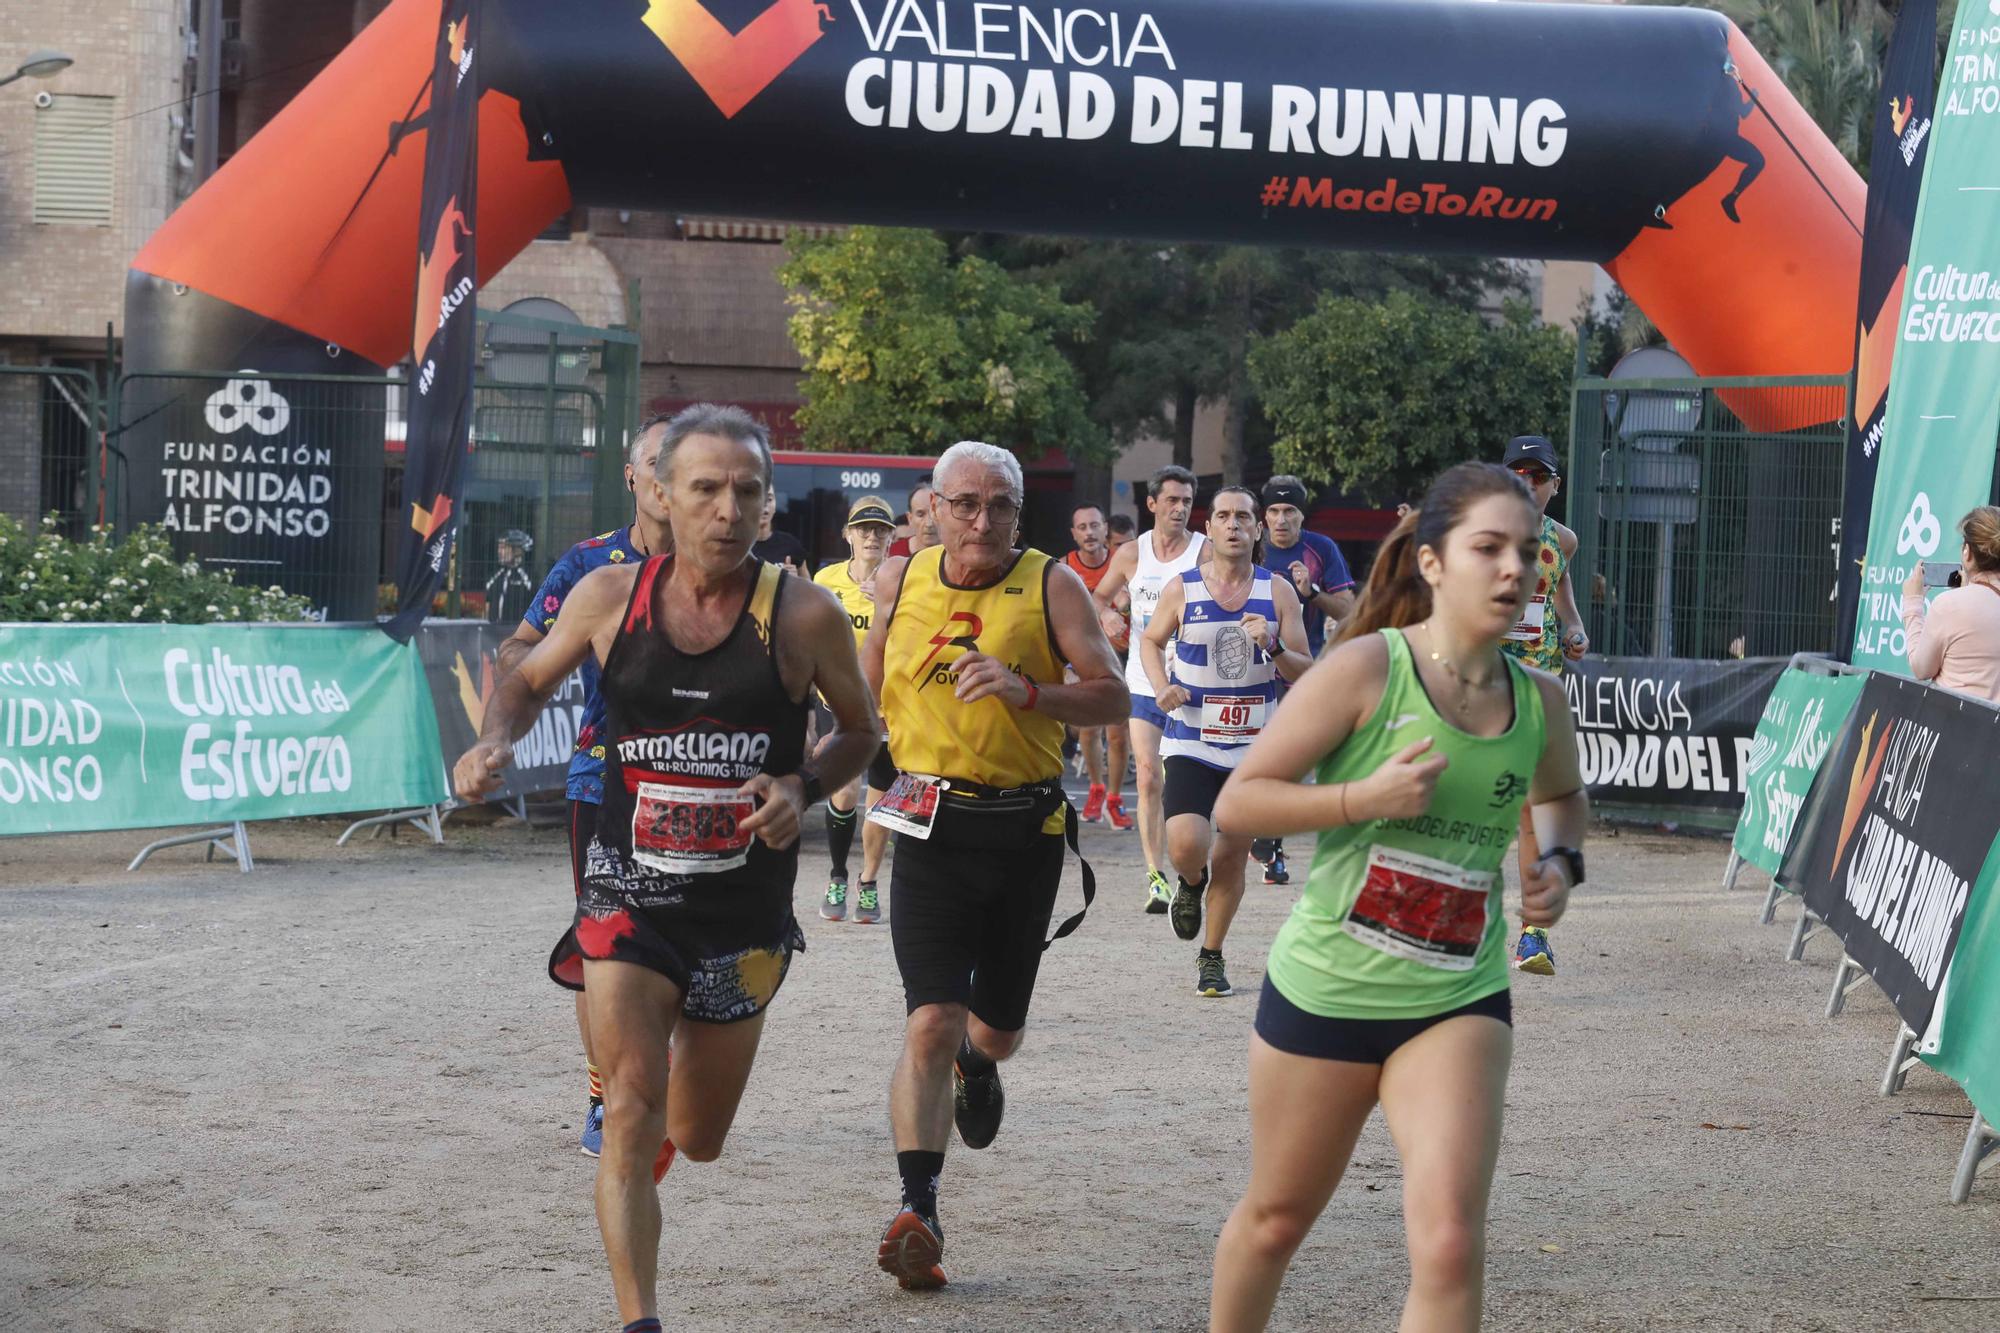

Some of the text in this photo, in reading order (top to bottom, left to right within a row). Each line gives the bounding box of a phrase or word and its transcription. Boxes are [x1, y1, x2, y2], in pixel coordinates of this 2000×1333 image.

[849, 0, 1176, 70] VALENCIA
[845, 57, 1568, 167] CIUDAD DEL RUNNING
[1260, 175, 1557, 222] #MadeToRun
[164, 442, 332, 466] FUNDACIÓN
[161, 468, 332, 504] TRINIDAD
[840, 471, 881, 489] 9009
[161, 502, 331, 538] ALFONSO
[163, 646, 351, 717] Cultura del
[0, 697, 102, 748] IDAD
[1218, 705, 1251, 726] 497
[179, 719, 353, 801] Esfuerzo
[1574, 731, 1661, 789] UDAD
[1664, 735, 1731, 793] DEL
